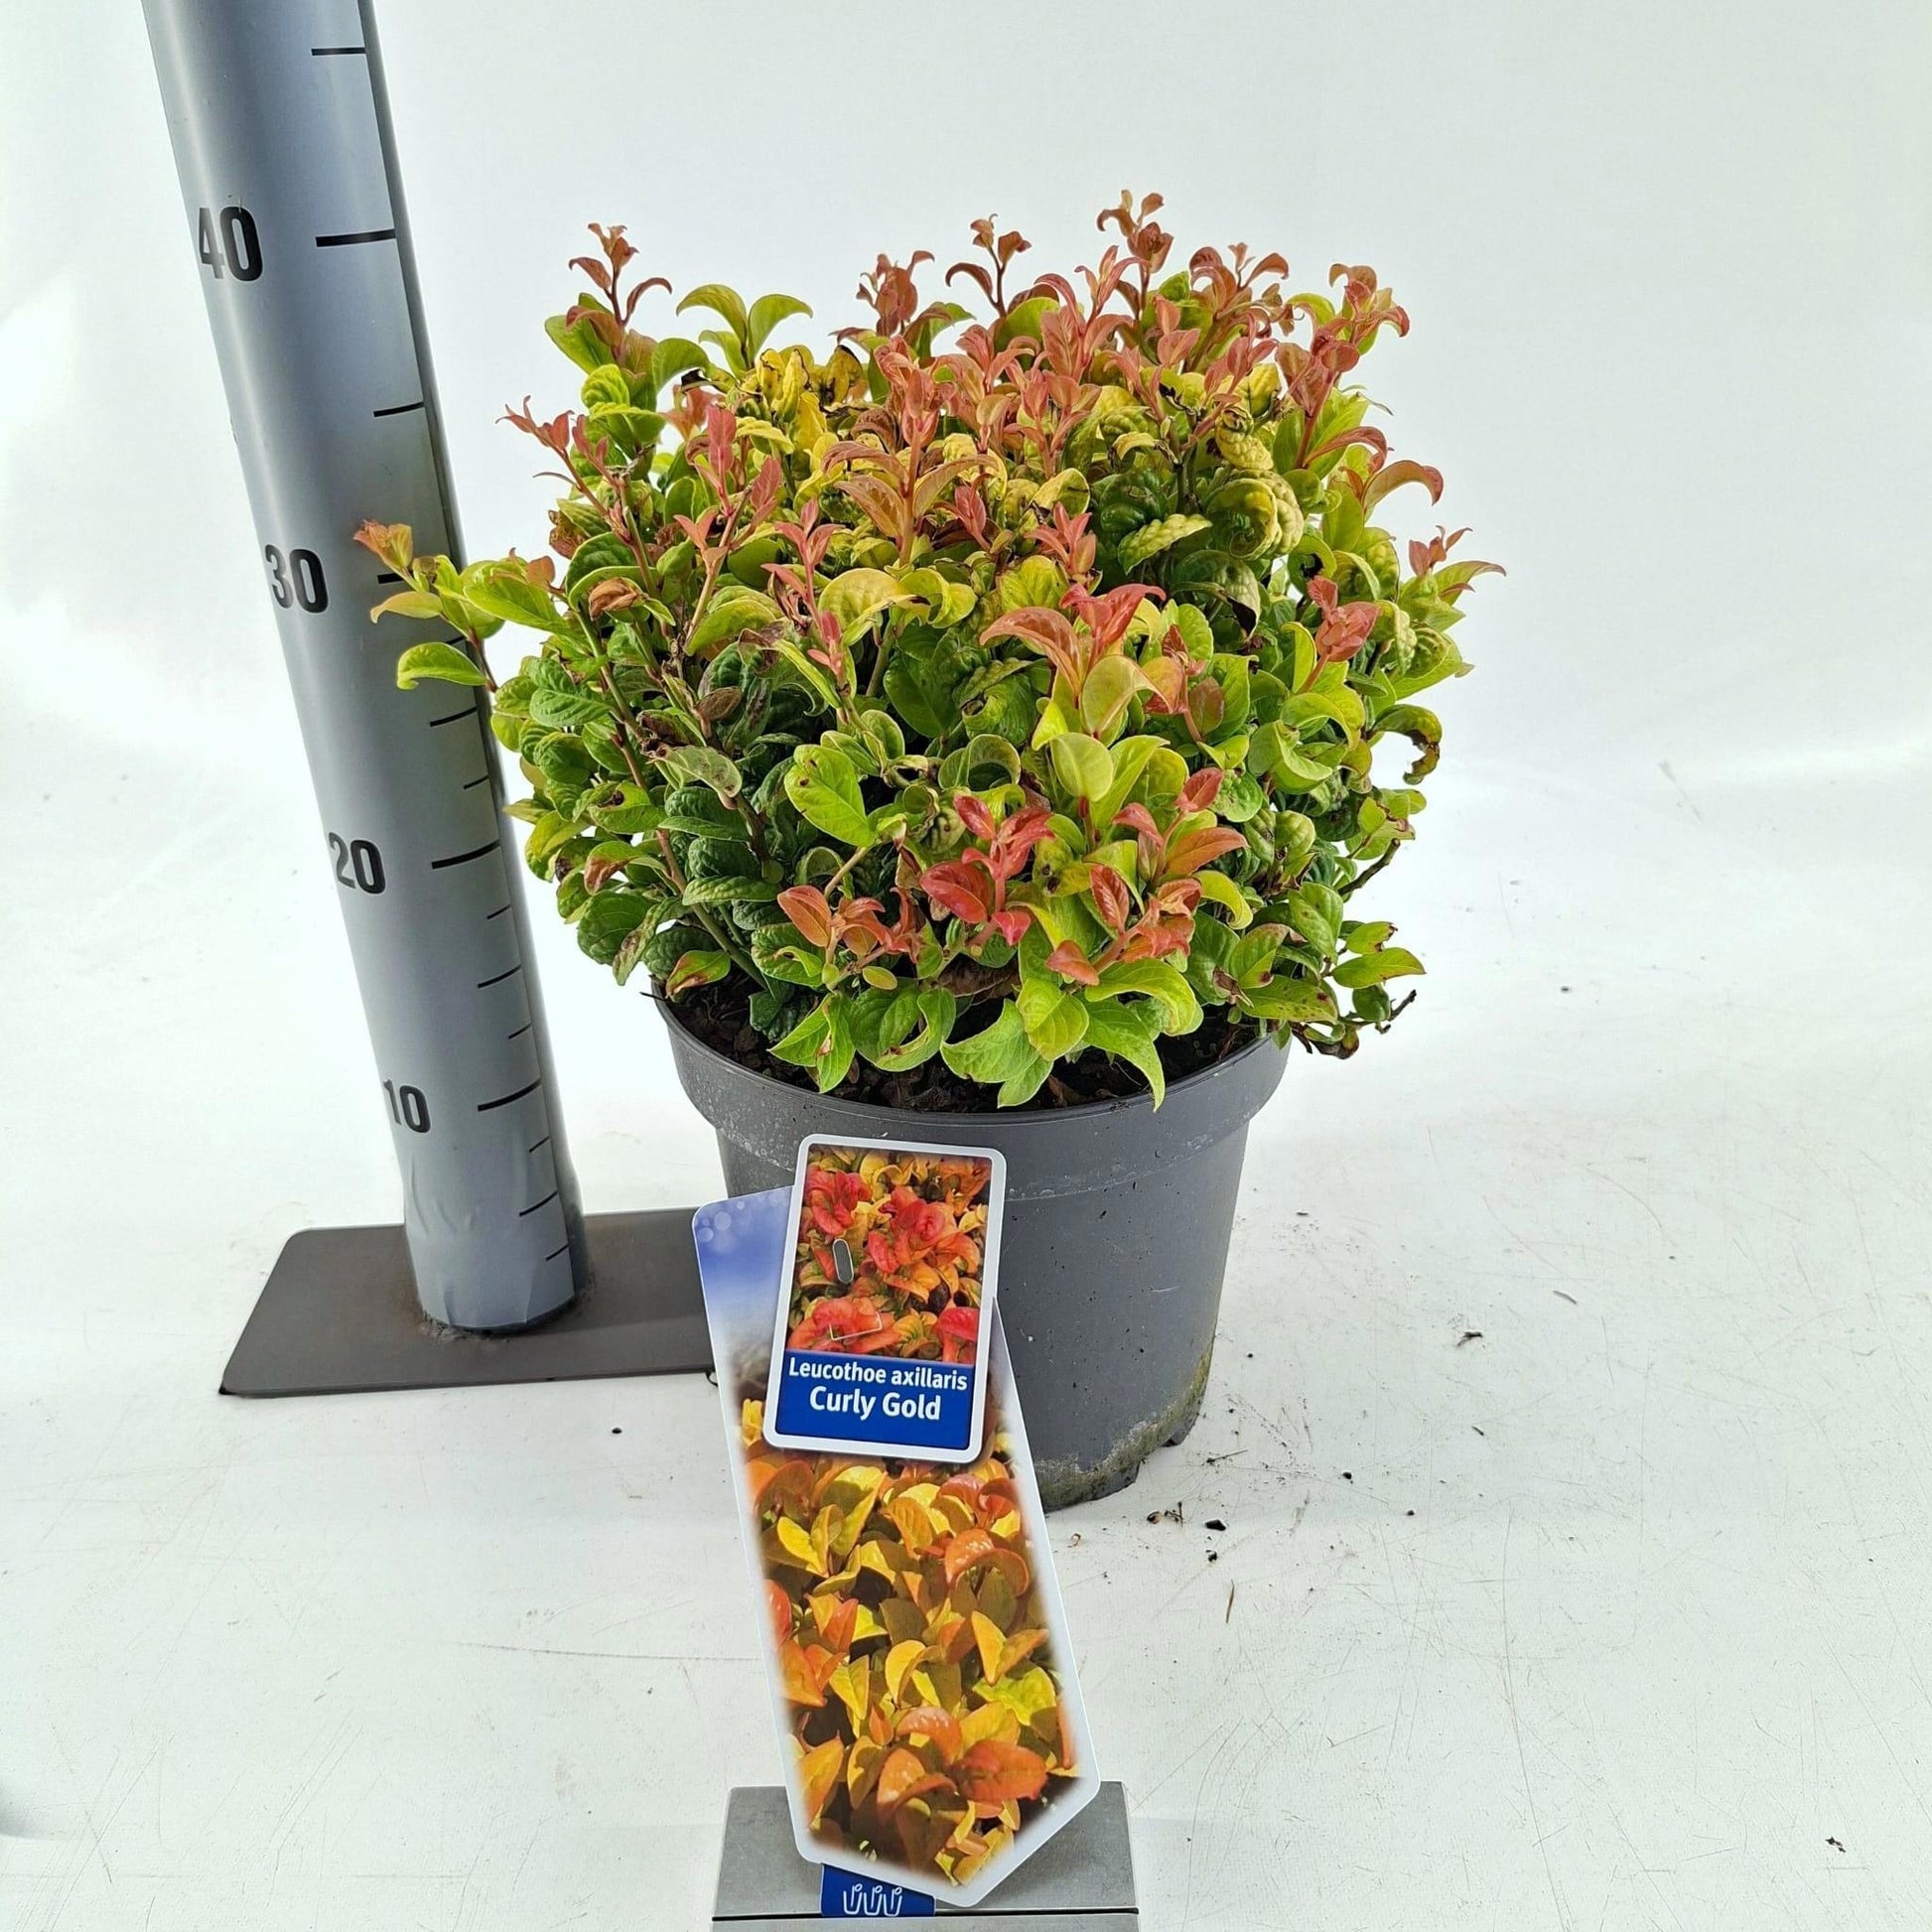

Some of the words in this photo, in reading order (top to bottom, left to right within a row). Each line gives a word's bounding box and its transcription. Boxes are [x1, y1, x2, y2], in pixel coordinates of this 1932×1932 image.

[199, 206, 264, 283] 40
[265, 543, 329, 615] 30
[329, 831, 387, 895] 20
[383, 1078, 432, 1134] 10
[788, 1356, 887, 1385] Leucothoe
[891, 1367, 968, 1391] axillaris
[809, 1386, 876, 1421] Curly
[882, 1392, 941, 1421] Gold
